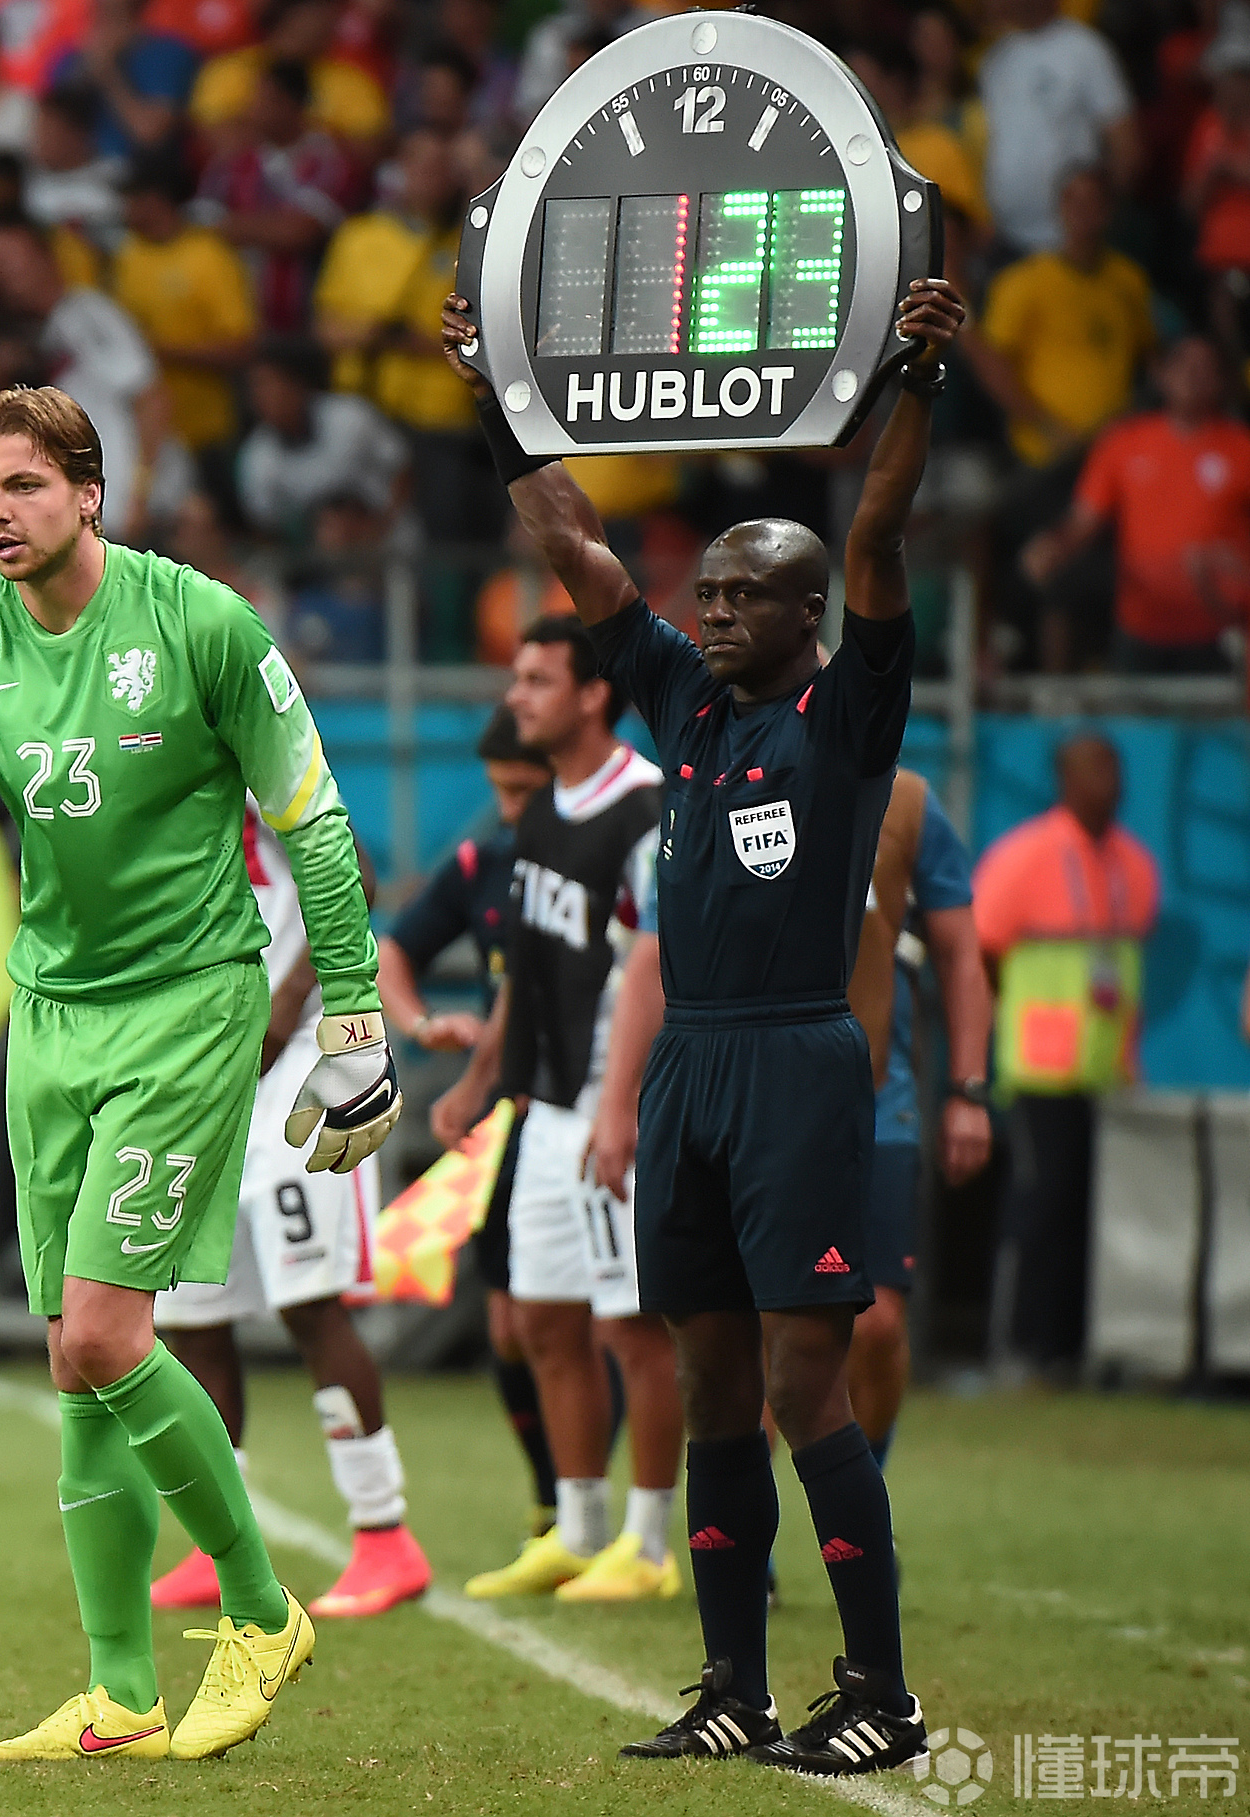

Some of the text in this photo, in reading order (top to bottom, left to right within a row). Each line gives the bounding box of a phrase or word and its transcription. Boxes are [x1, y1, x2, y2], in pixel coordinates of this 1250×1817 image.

[612, 66, 789, 114] 55 60 05
[673, 86, 726, 133] 12
[691, 189, 845, 354] 23
[566, 366, 795, 422] HUBLOT
[16, 737, 102, 820] 23
[734, 807, 786, 826] REFEREE
[742, 830, 788, 852] FIFA
[758, 863, 781, 874] 2014
[341, 1019, 373, 1044] TK
[105, 1146, 198, 1231] 23
[277, 1183, 313, 1243] 9
